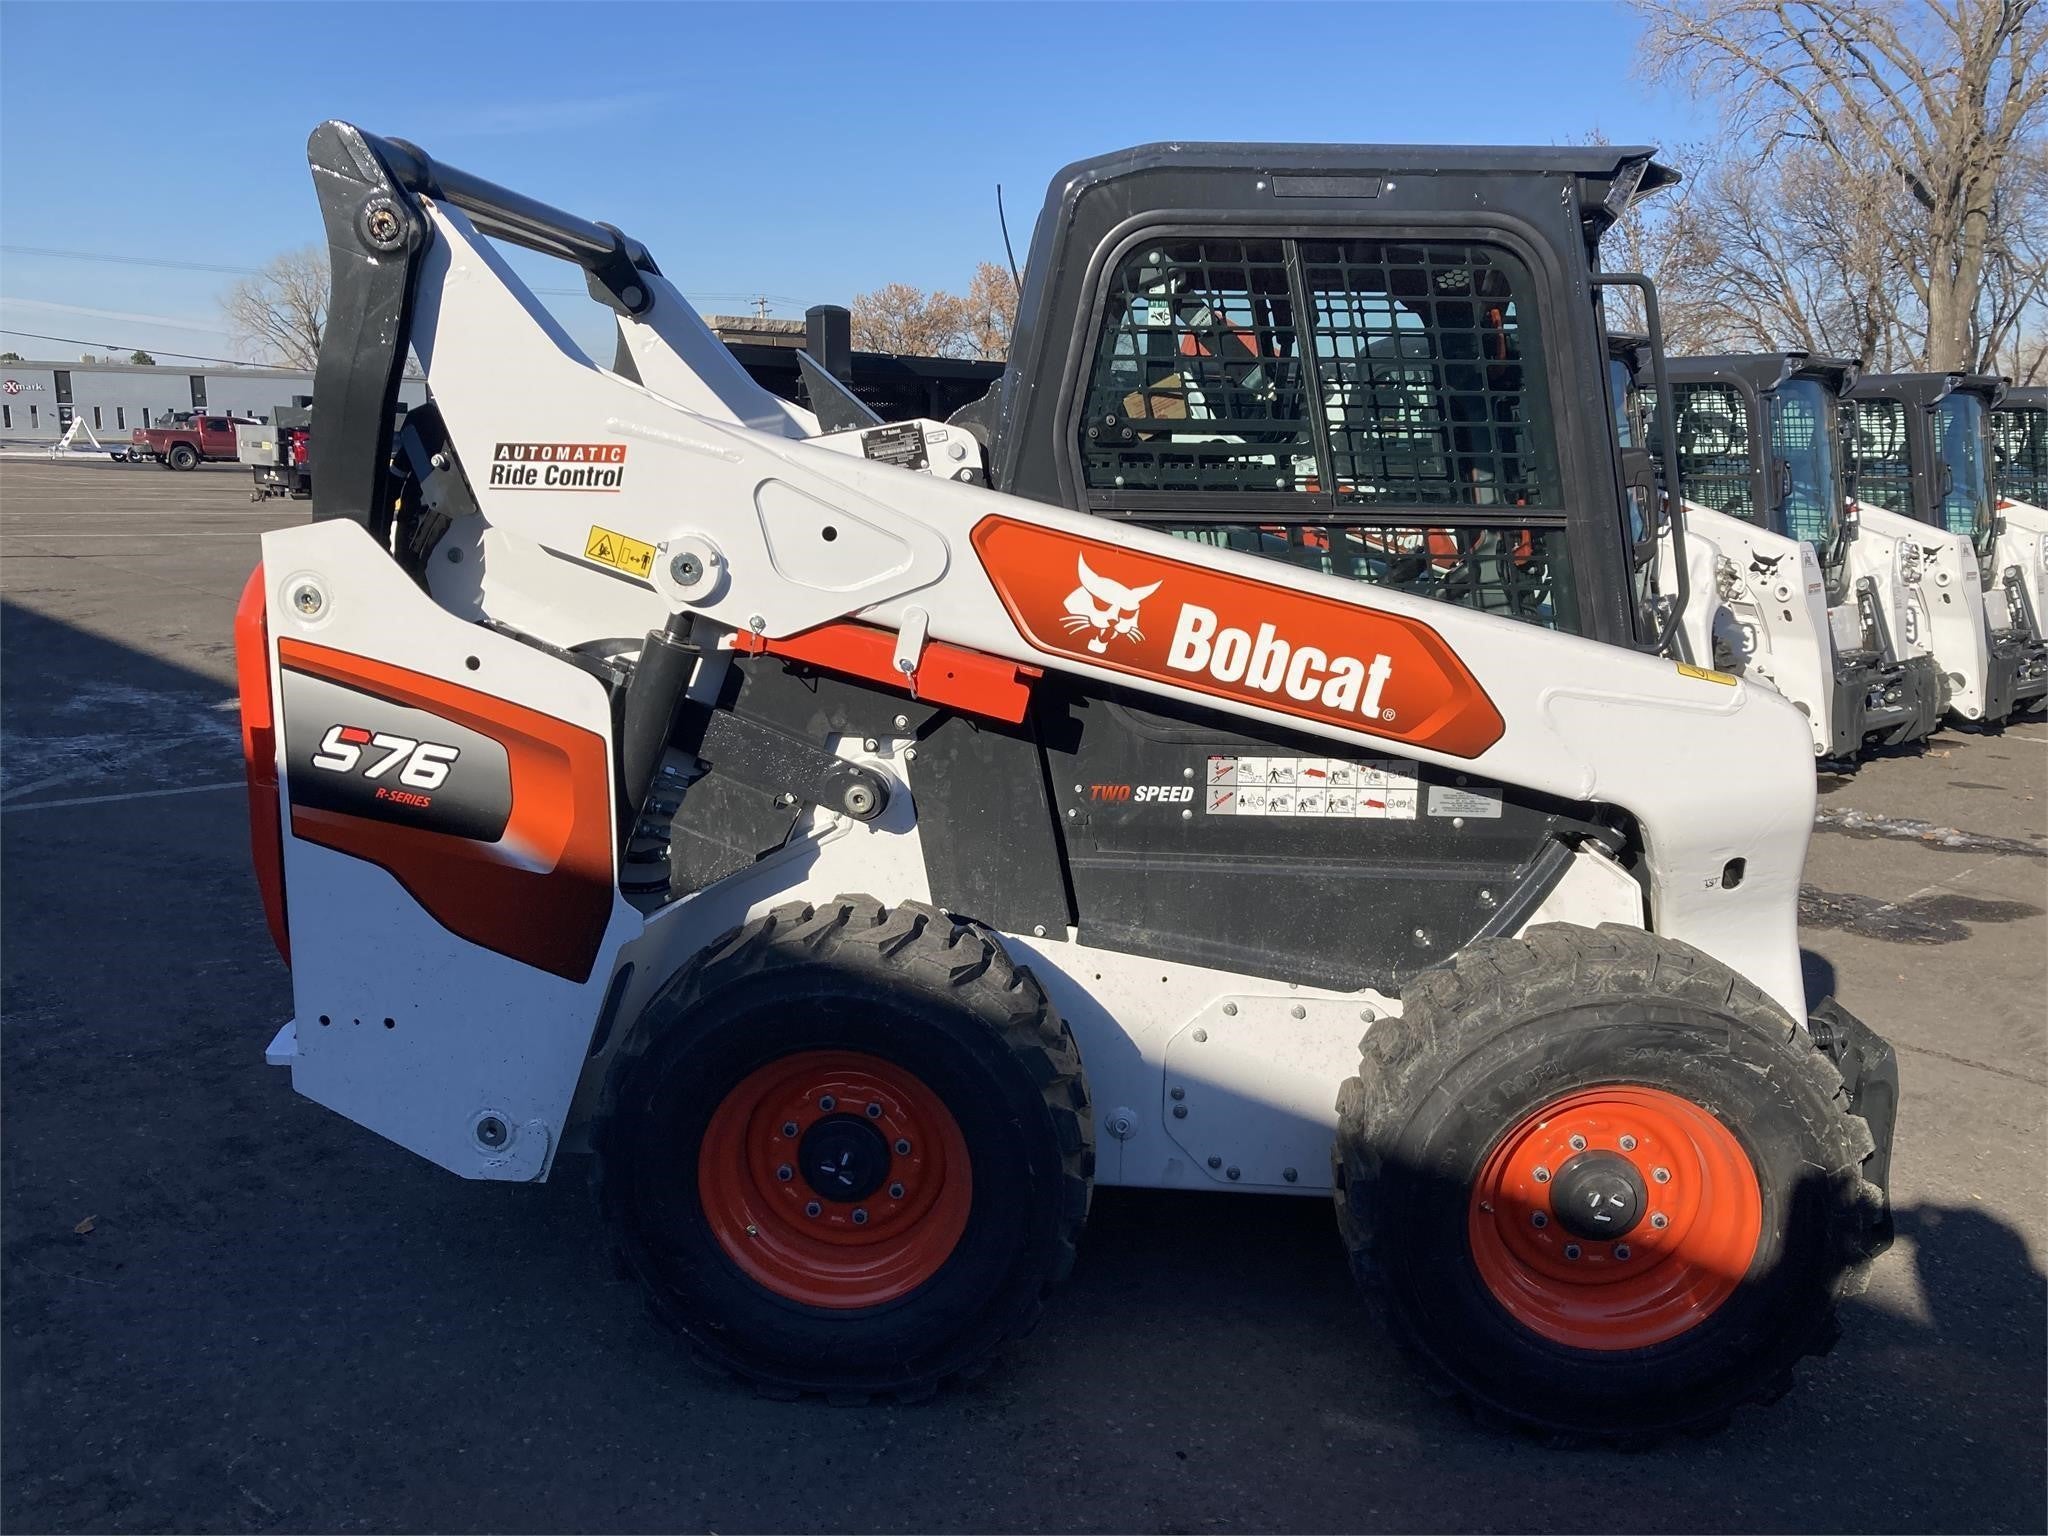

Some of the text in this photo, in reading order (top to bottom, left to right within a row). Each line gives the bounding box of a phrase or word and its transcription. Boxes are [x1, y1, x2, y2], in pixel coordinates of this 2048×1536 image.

[498, 445, 621, 461] AUTOMATIC
[489, 464, 624, 487] Ride Control
[1166, 602, 1393, 720] Bobcat
[312, 724, 460, 790] S76
[376, 787, 431, 807] R-SERIES
[1090, 785, 1194, 803] TWO SPEED
